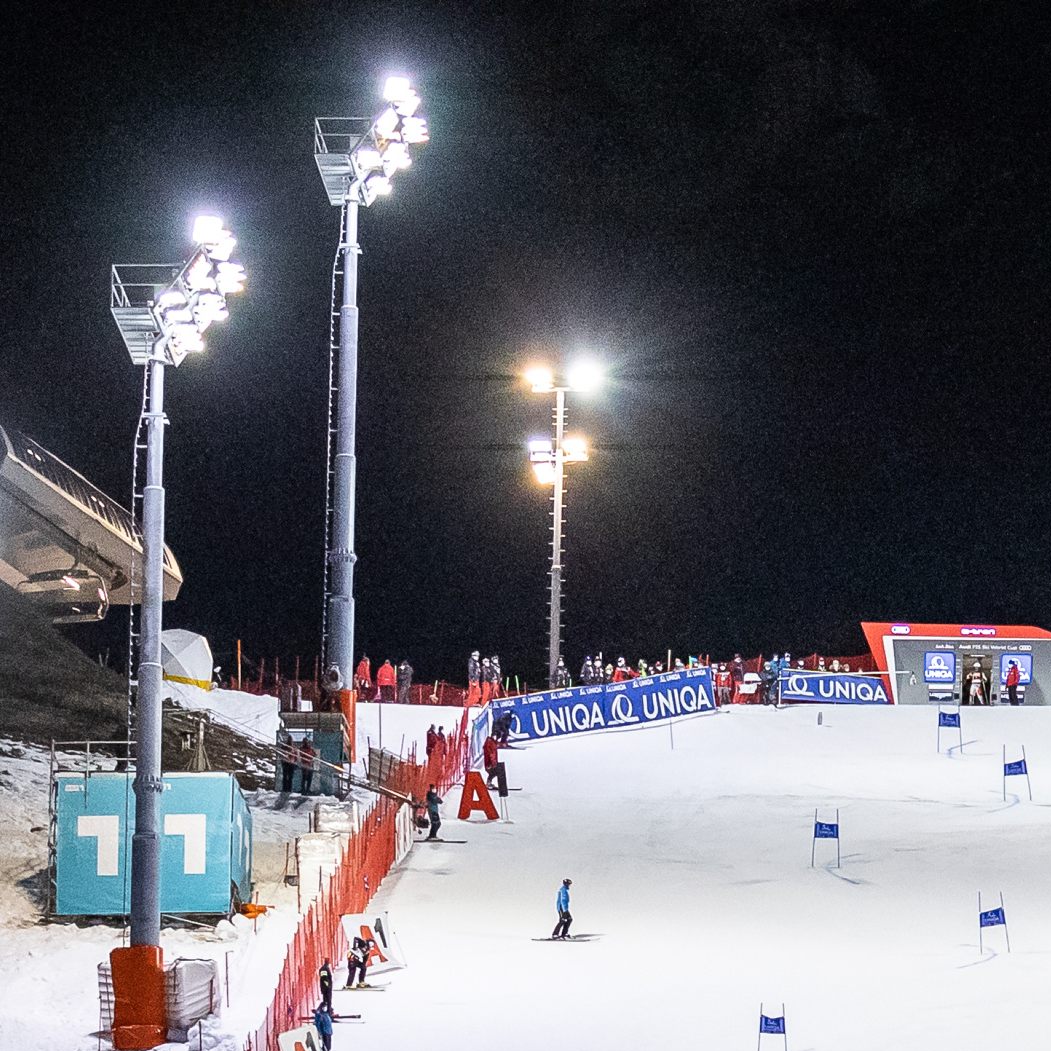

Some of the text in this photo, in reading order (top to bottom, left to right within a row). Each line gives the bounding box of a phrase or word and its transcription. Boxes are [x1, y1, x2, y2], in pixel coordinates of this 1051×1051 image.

[642, 684, 712, 719] UNIQA
[819, 679, 888, 702] UNIQA
[531, 702, 605, 736] UNIQA
